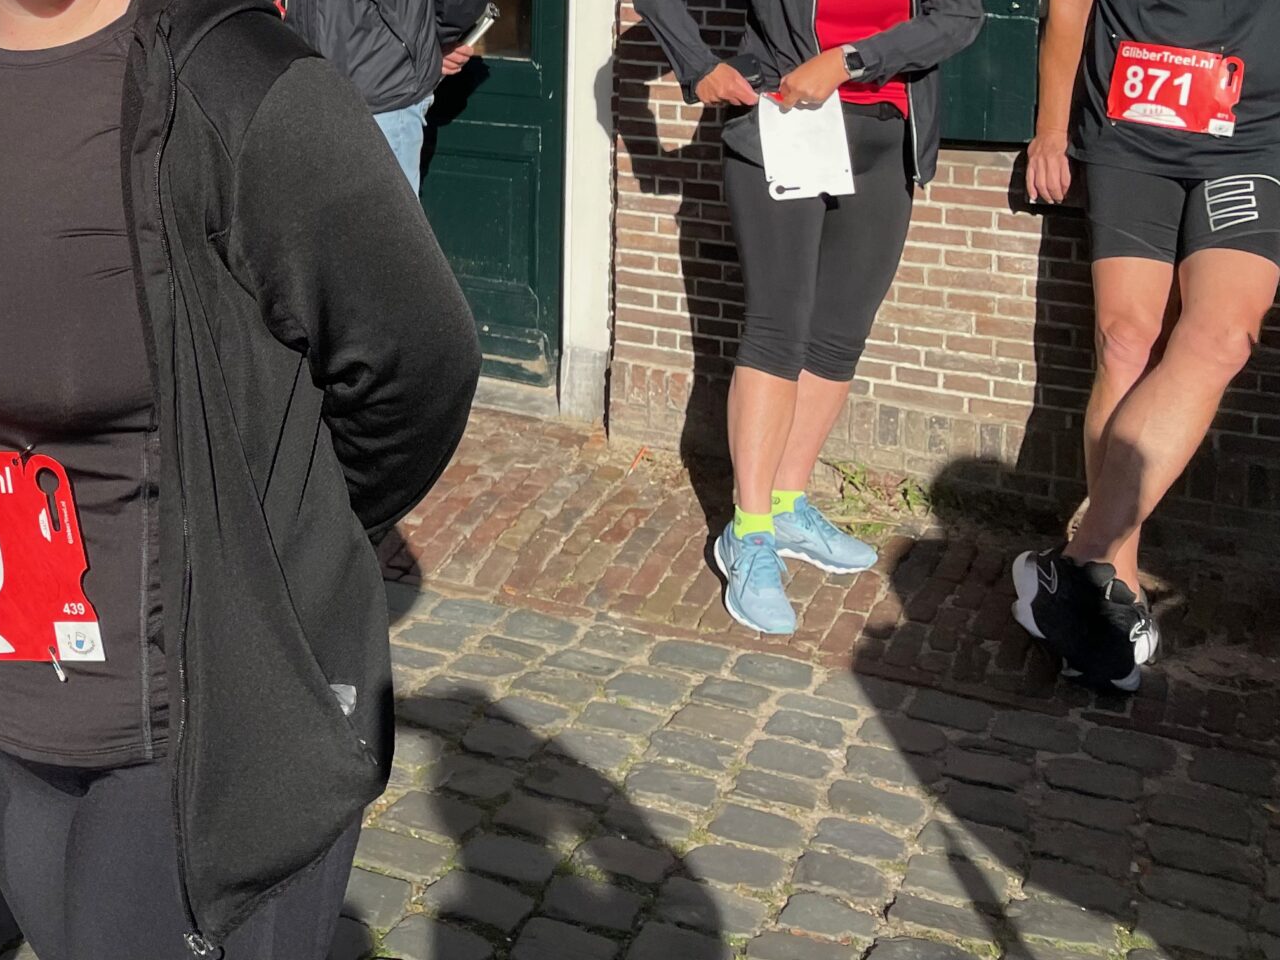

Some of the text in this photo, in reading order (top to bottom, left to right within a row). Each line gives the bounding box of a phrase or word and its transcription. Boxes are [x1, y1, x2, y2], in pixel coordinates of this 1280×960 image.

[1122, 46, 1215, 70] GlibberTreel.nl
[1123, 65, 1193, 106] 871
[63, 602, 86, 615] 439
